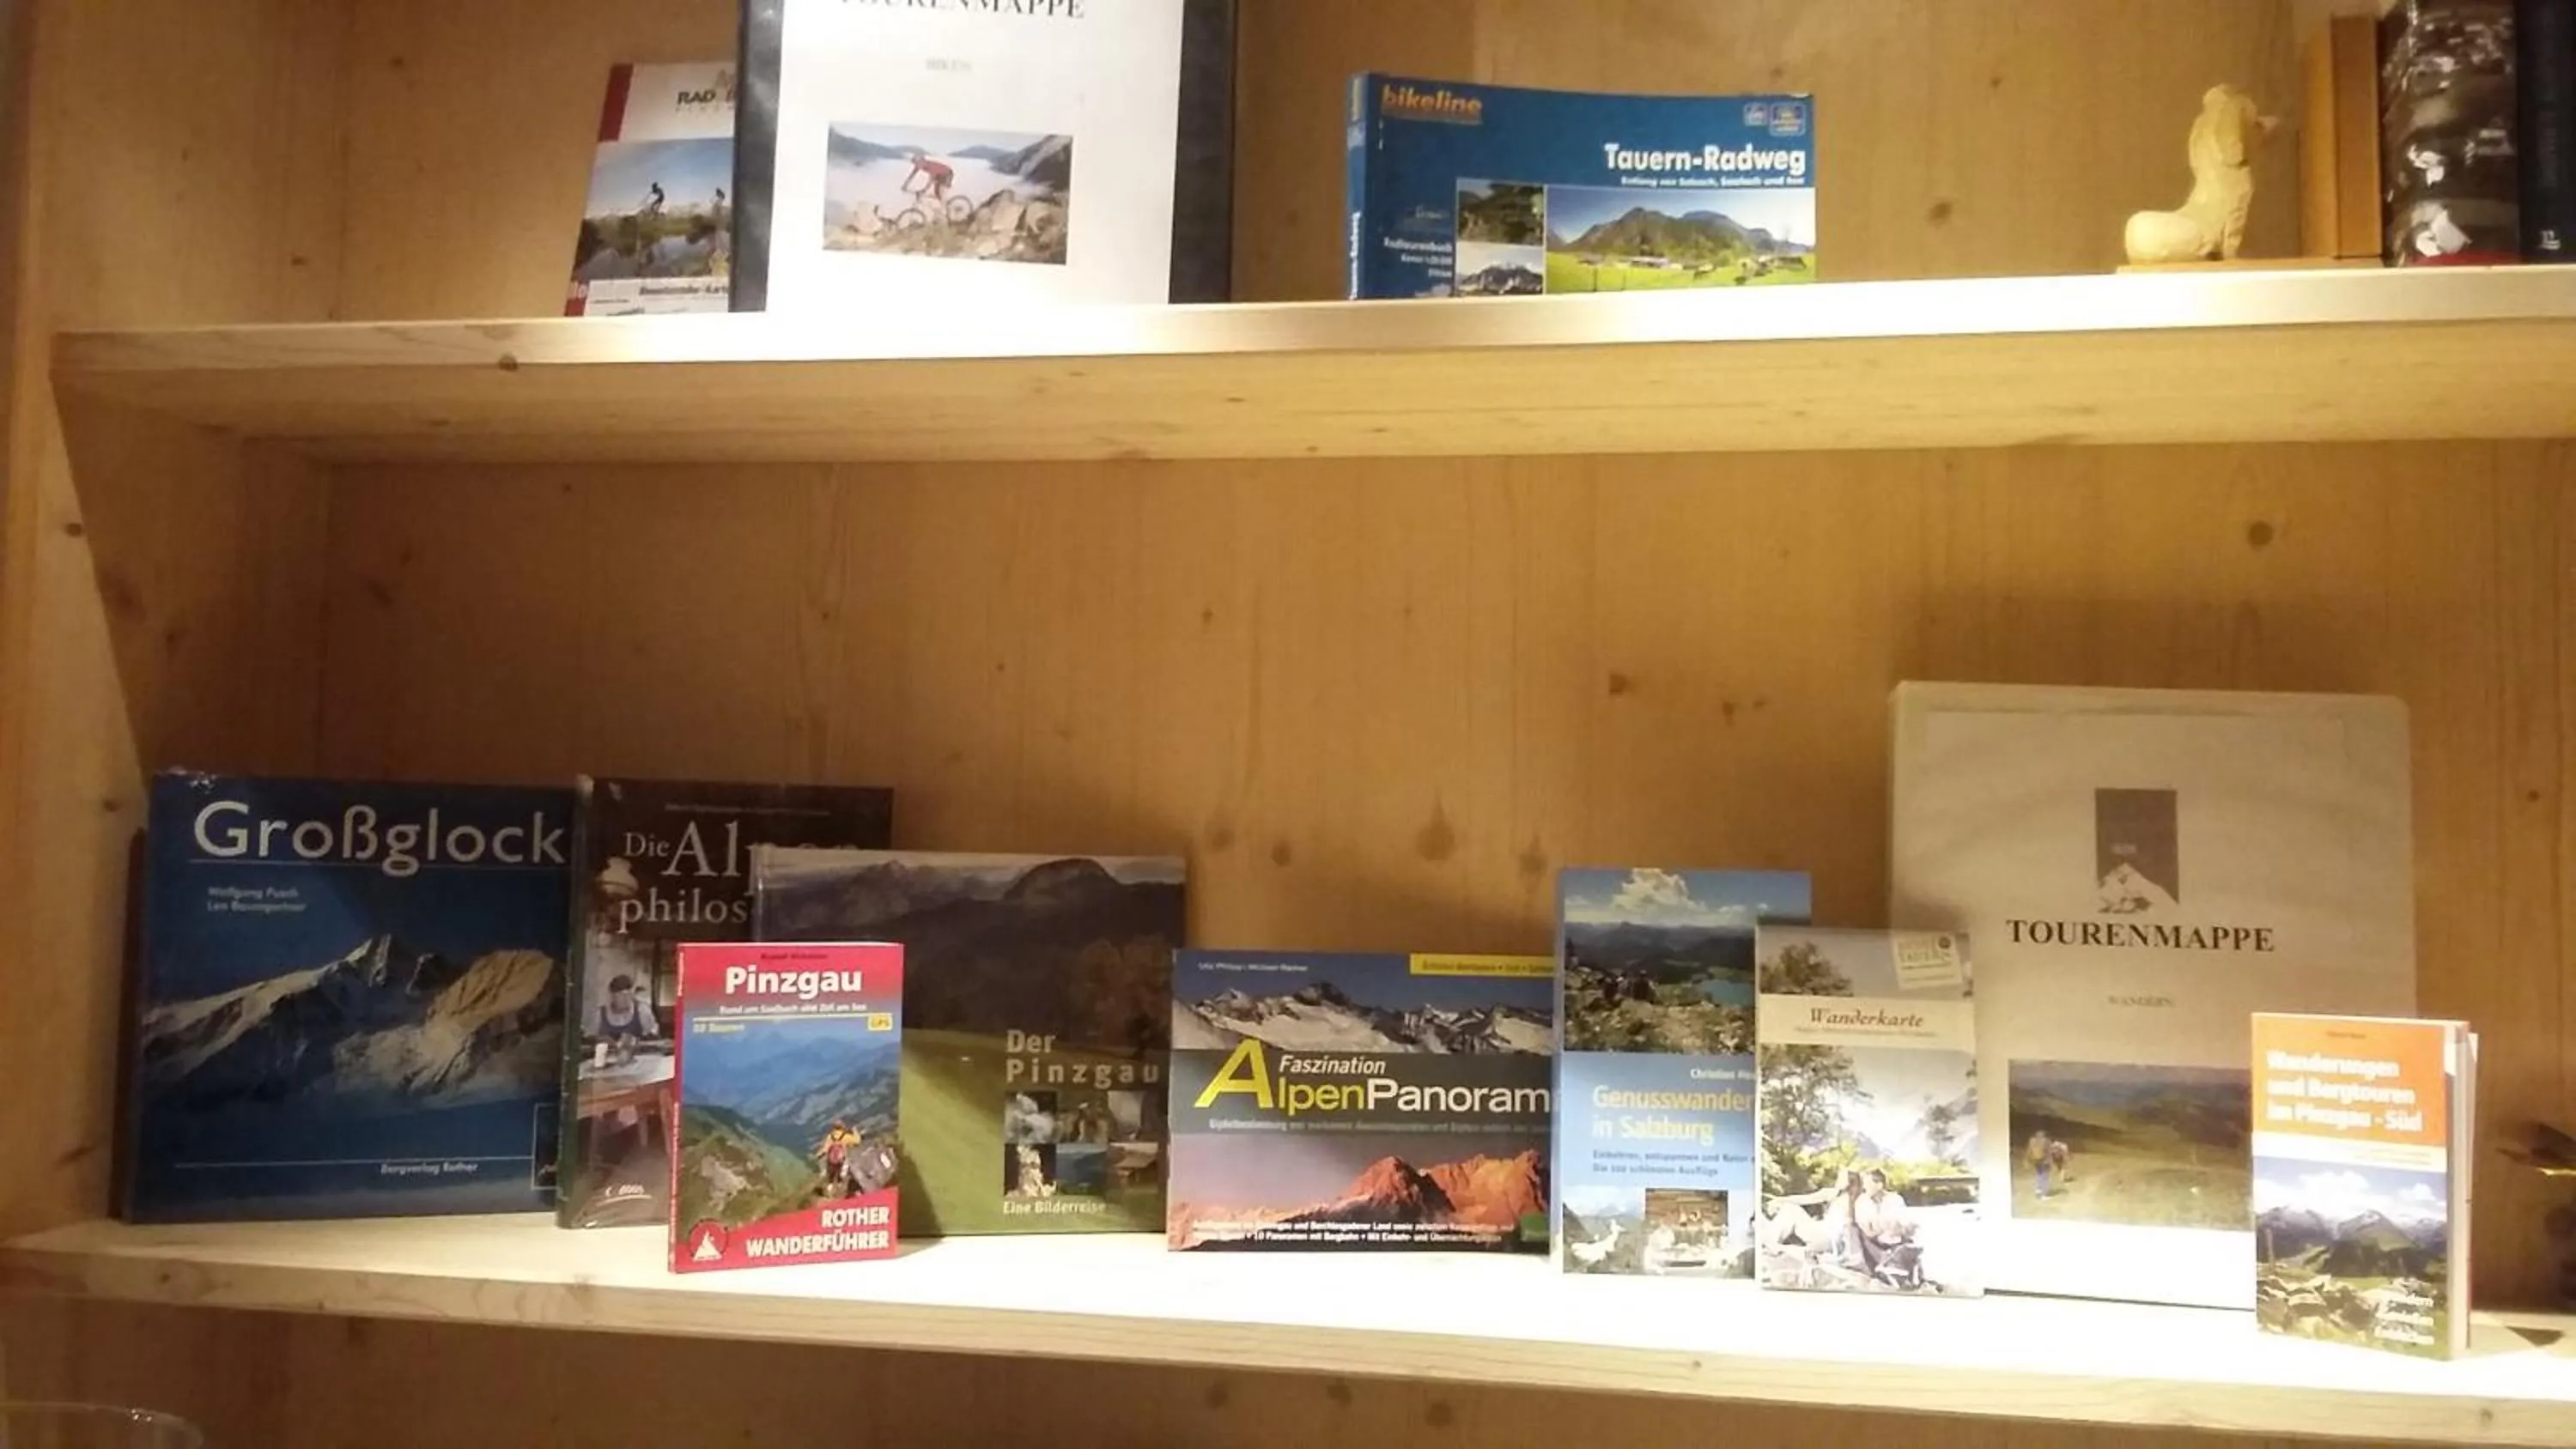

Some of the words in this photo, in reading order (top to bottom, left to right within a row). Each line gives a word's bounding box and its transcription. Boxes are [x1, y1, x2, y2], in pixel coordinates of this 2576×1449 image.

[677, 88, 716, 106] RAD
[1382, 83, 1483, 116] bikeline
[1604, 142, 1806, 175] Tauern-Radweg
[194, 800, 566, 876] Großglock
[624, 831, 670, 858] Die
[616, 888, 749, 934] philos
[2006, 918, 2275, 953] TOURENMAPPE
[725, 963, 862, 1000] Pinzgau
[1810, 1007, 1924, 1028] Wanderkarte
[1005, 1029, 1056, 1054] Der
[1005, 1058, 1159, 1089] Pinzgau
[1279, 1054, 1386, 1076] Faszination
[2266, 1048, 2400, 1081] Wanderungen
[2266, 1076, 2306, 1096] und
[2307, 1076, 2417, 1105] Bergtouren
[1593, 1114, 1613, 1139] in
[1619, 1114, 1715, 1147] Salzburg
[2293, 1101, 2372, 1131] Pinzgau
[822, 1206, 890, 1228] ROTHER
[1003, 1201, 1031, 1215] Eine
[1035, 1200, 1107, 1215] Bilderreise
[745, 1229, 890, 1258] WANDERFÜHRER
